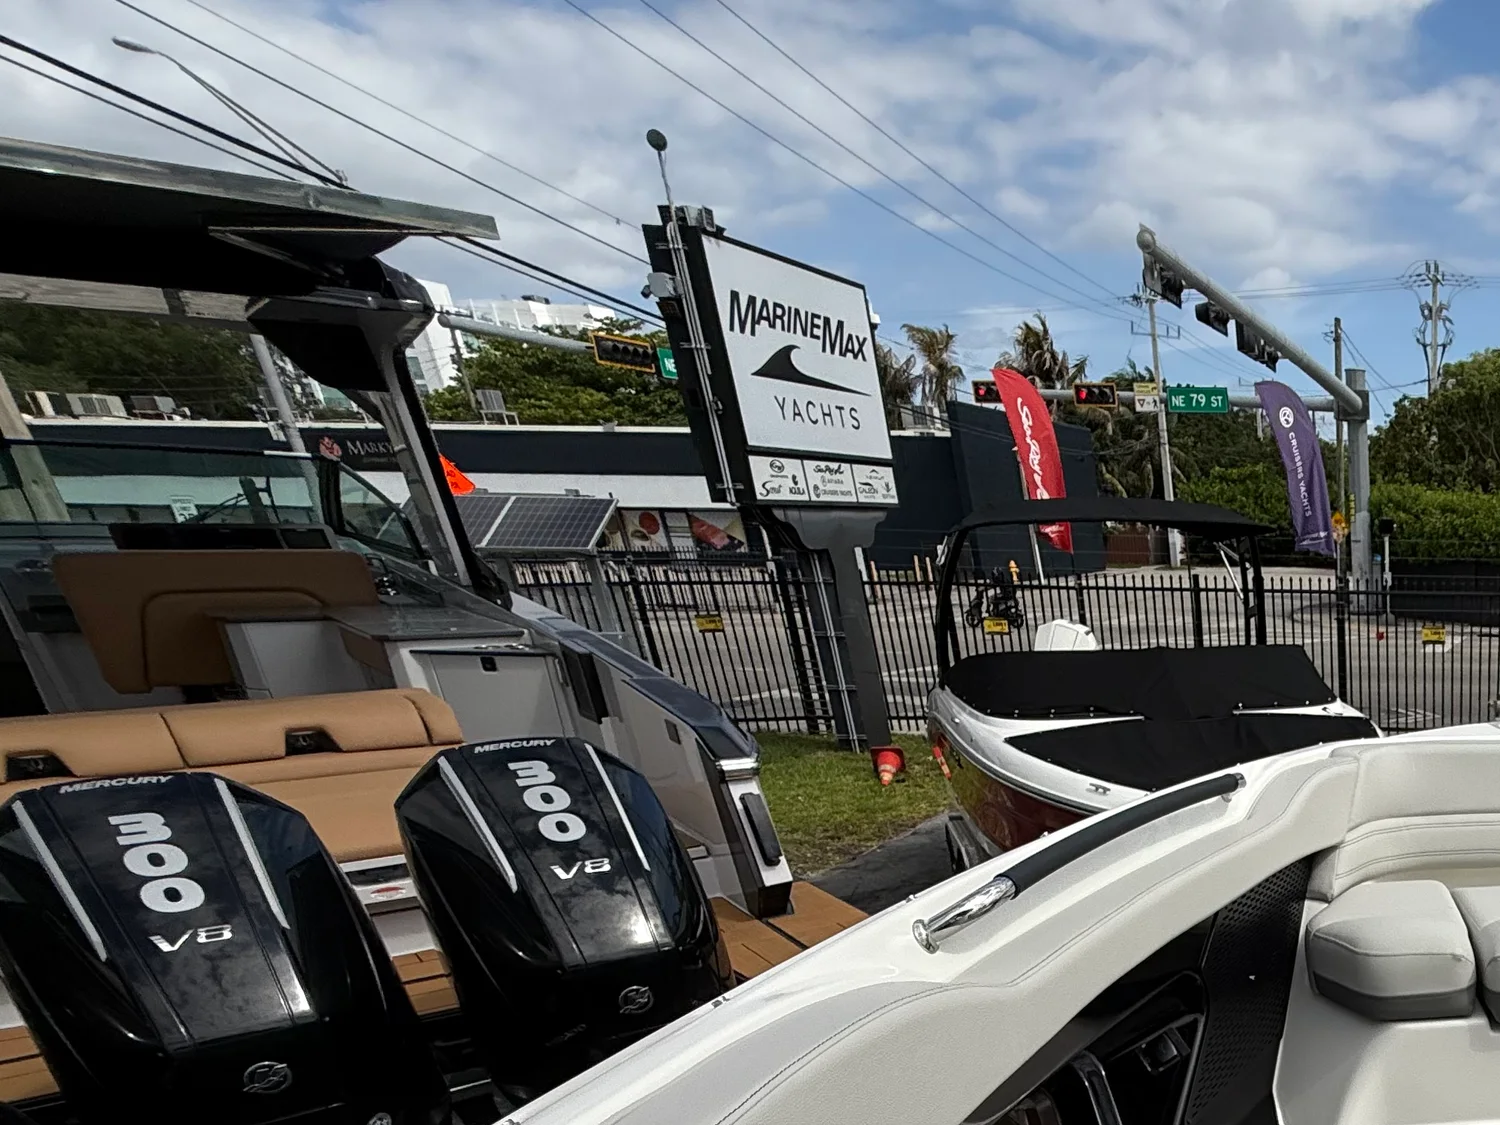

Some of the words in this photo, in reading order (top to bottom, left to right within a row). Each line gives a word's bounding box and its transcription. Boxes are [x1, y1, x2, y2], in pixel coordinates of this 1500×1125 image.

[664, 357, 677, 373] NE
[774, 395, 860, 430] YACHTS
[1171, 395, 1186, 407] NE
[1189, 393, 1207, 407] 79
[1211, 395, 1223, 408] ST
[1288, 431, 1304, 479] CRUISERS
[1298, 480, 1313, 517] YACHTS
[474, 739, 557, 754] MERCURY
[59, 775, 174, 794] MERCURY
[507, 760, 587, 842] 300
[107, 812, 206, 913] 300
[550, 858, 611, 880] V8
[149, 924, 233, 952] V8
